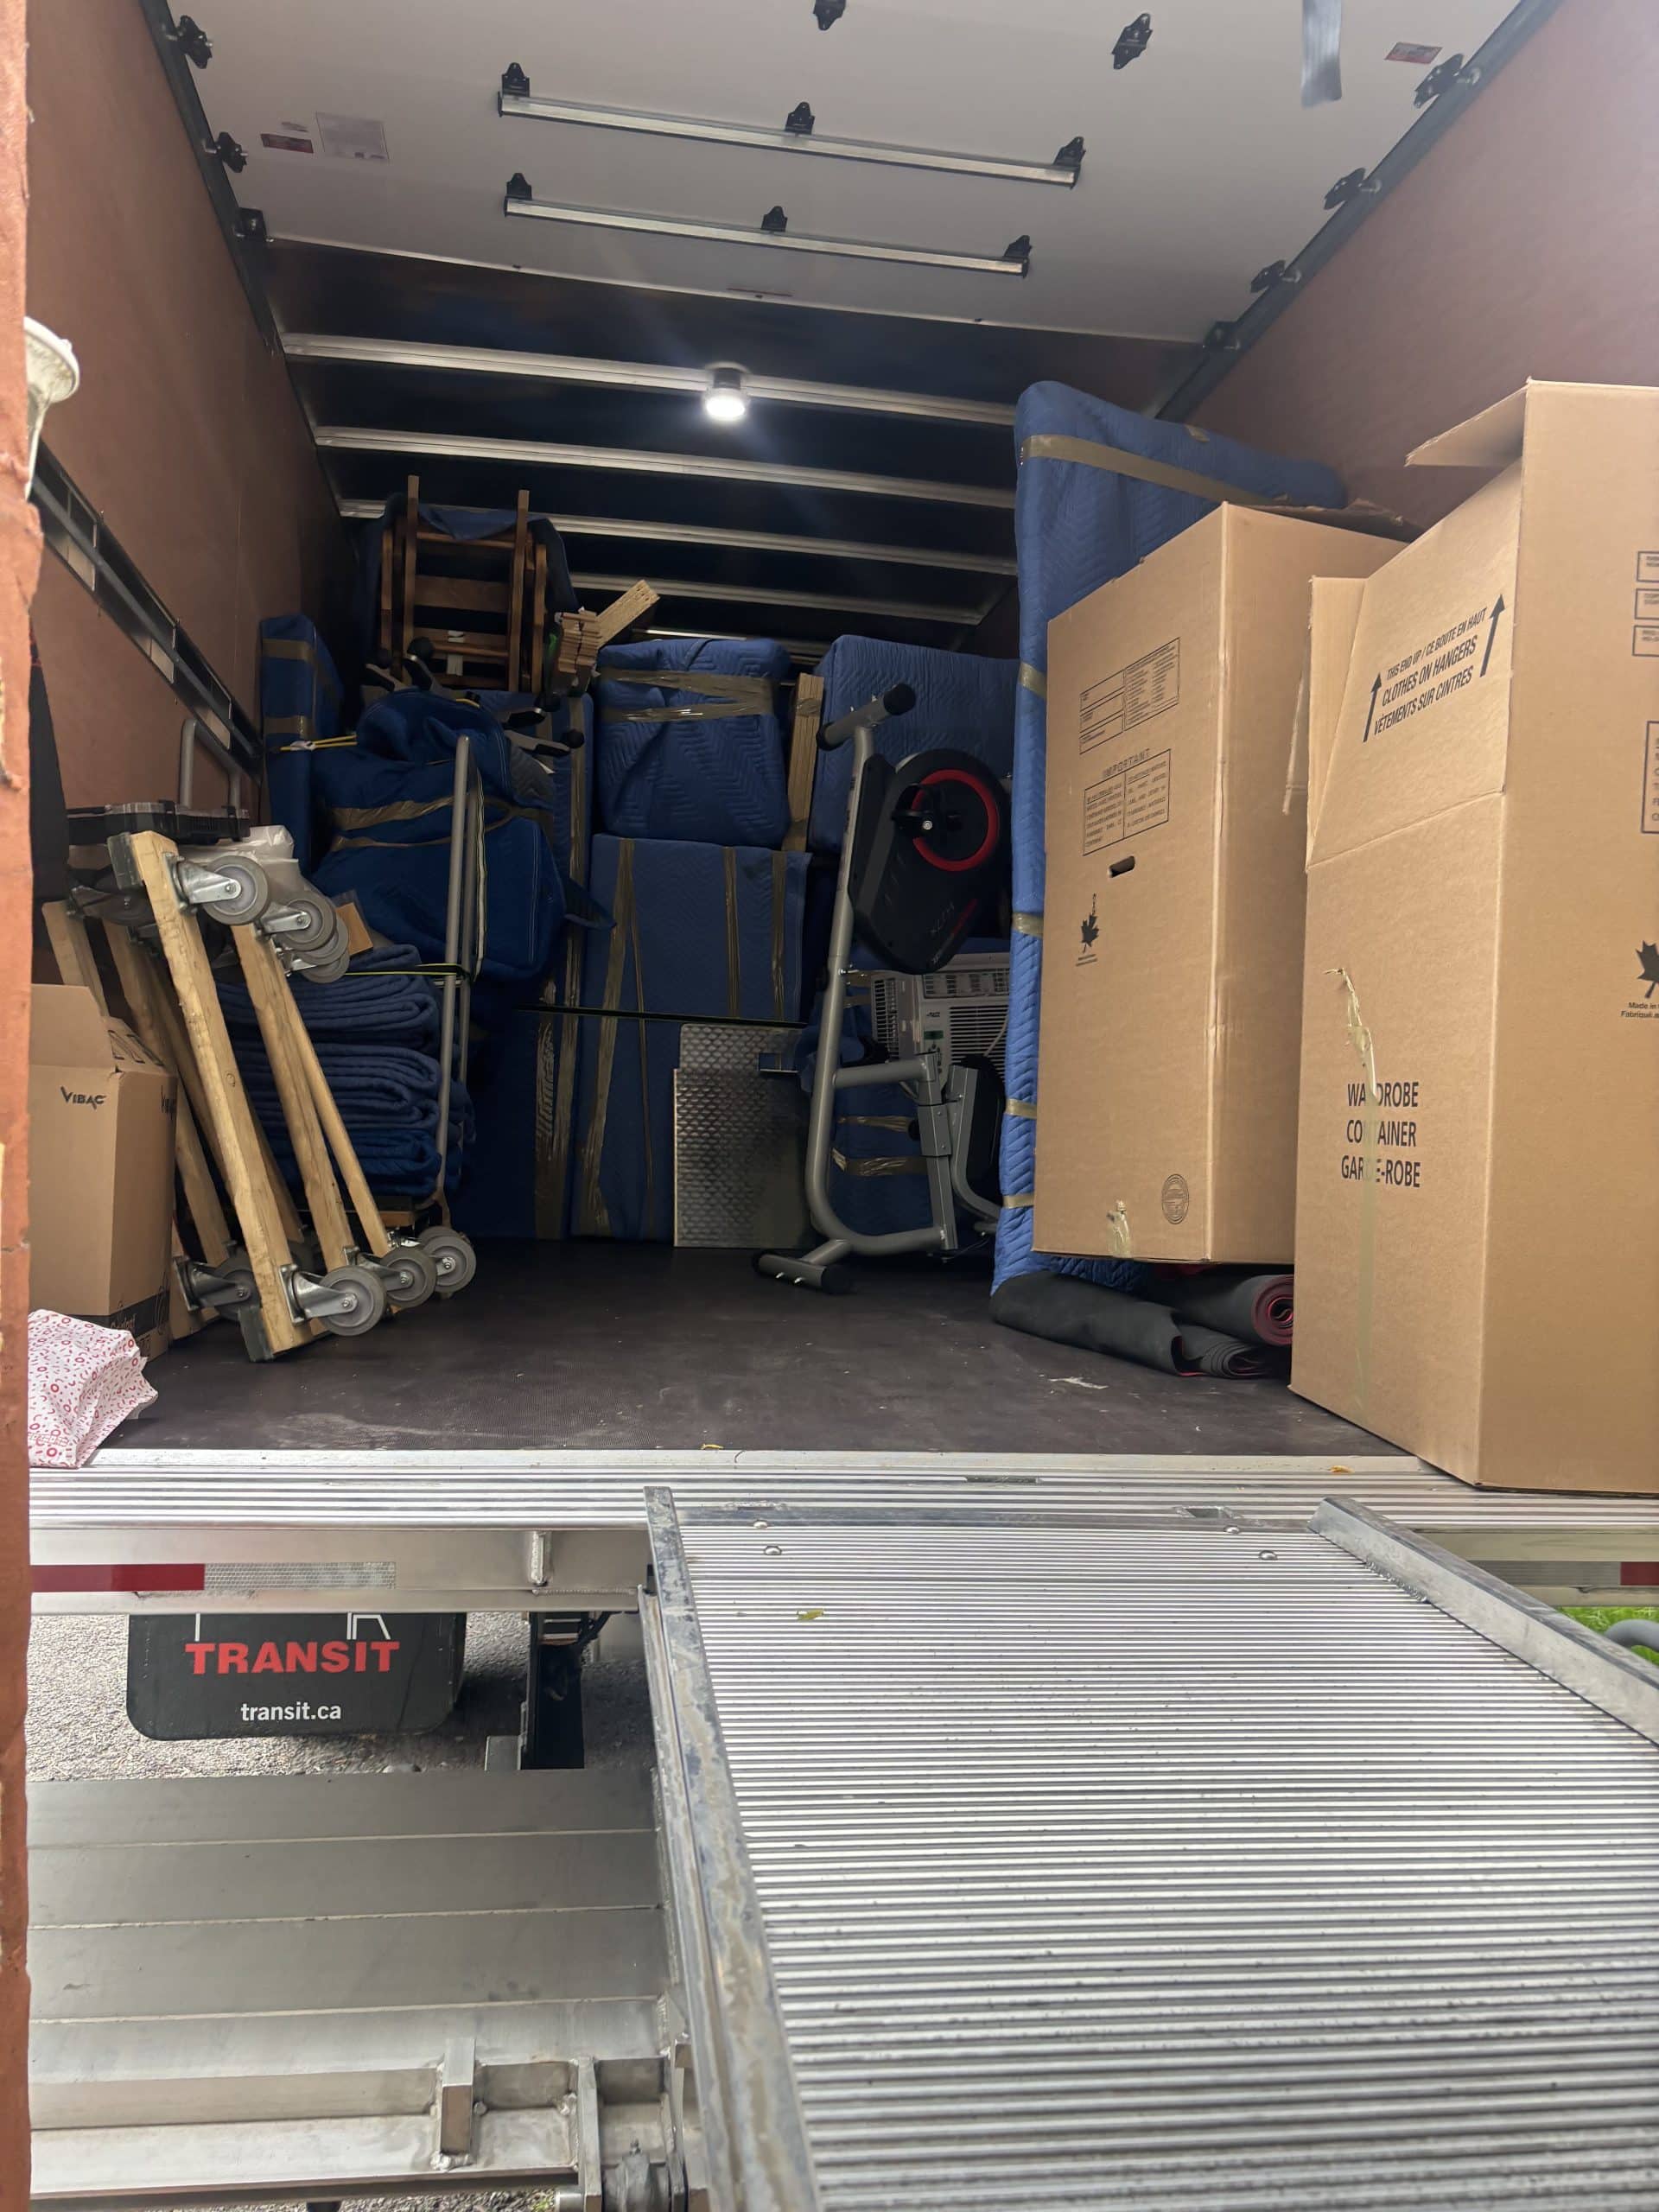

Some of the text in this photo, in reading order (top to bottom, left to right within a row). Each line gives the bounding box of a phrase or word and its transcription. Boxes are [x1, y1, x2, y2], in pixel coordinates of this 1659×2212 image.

[1387, 663, 1401, 681] THIS
[1400, 655, 1412, 673] END
[1412, 649, 1422, 664] UP
[1434, 626, 1458, 652] BOUTE
[1457, 620, 1468, 637] EN
[1466, 607, 1488, 631] HAUT
[1382, 634, 1478, 707] CLOTHES ON HANGERS
[1417, 687, 1435, 713] SUR
[1435, 664, 1474, 702] CINTRES
[60, 1085, 107, 1111] VIBAC
[1347, 1081, 1419, 1107] WADROBE
[1346, 1119, 1417, 1147] COAINER
[1341, 1154, 1421, 1188] GARE-ROBE
[185, 1641, 400, 1675] TRANSIT
[241, 1701, 341, 1722] transit.ca
